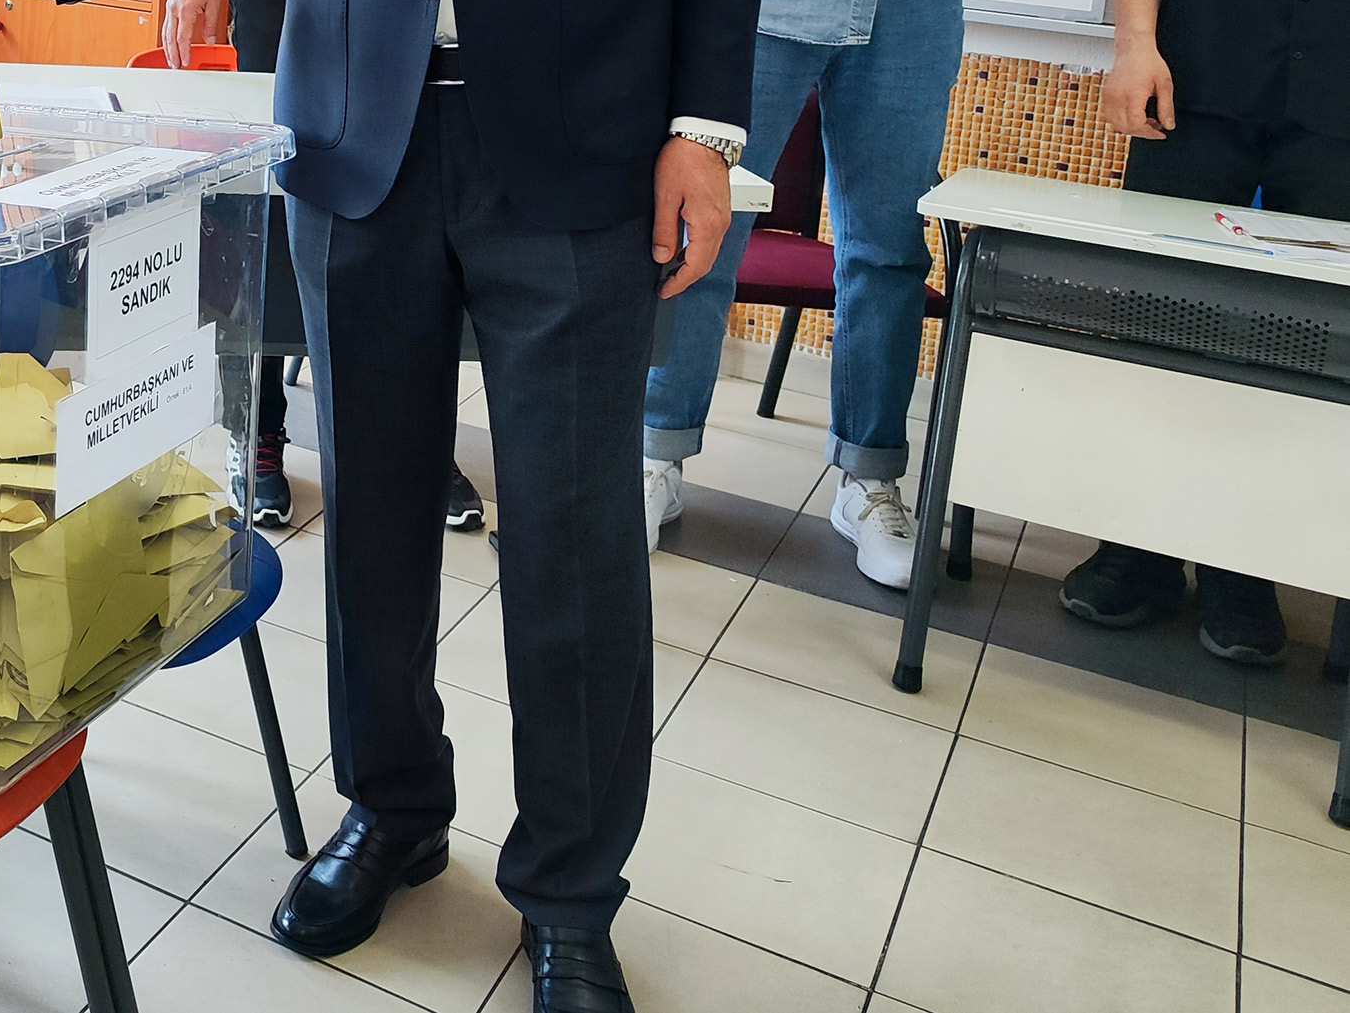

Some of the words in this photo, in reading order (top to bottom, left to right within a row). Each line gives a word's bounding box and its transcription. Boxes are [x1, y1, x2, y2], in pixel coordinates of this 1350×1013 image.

[109, 264, 140, 292] 2294
[143, 242, 183, 277] NO.LU
[121, 275, 172, 316] SANDIK
[84, 362, 180, 427] CUMHURBAŞKANI
[181, 354, 195, 377] VE
[86, 391, 160, 450] MİLLETVEKİLİ
